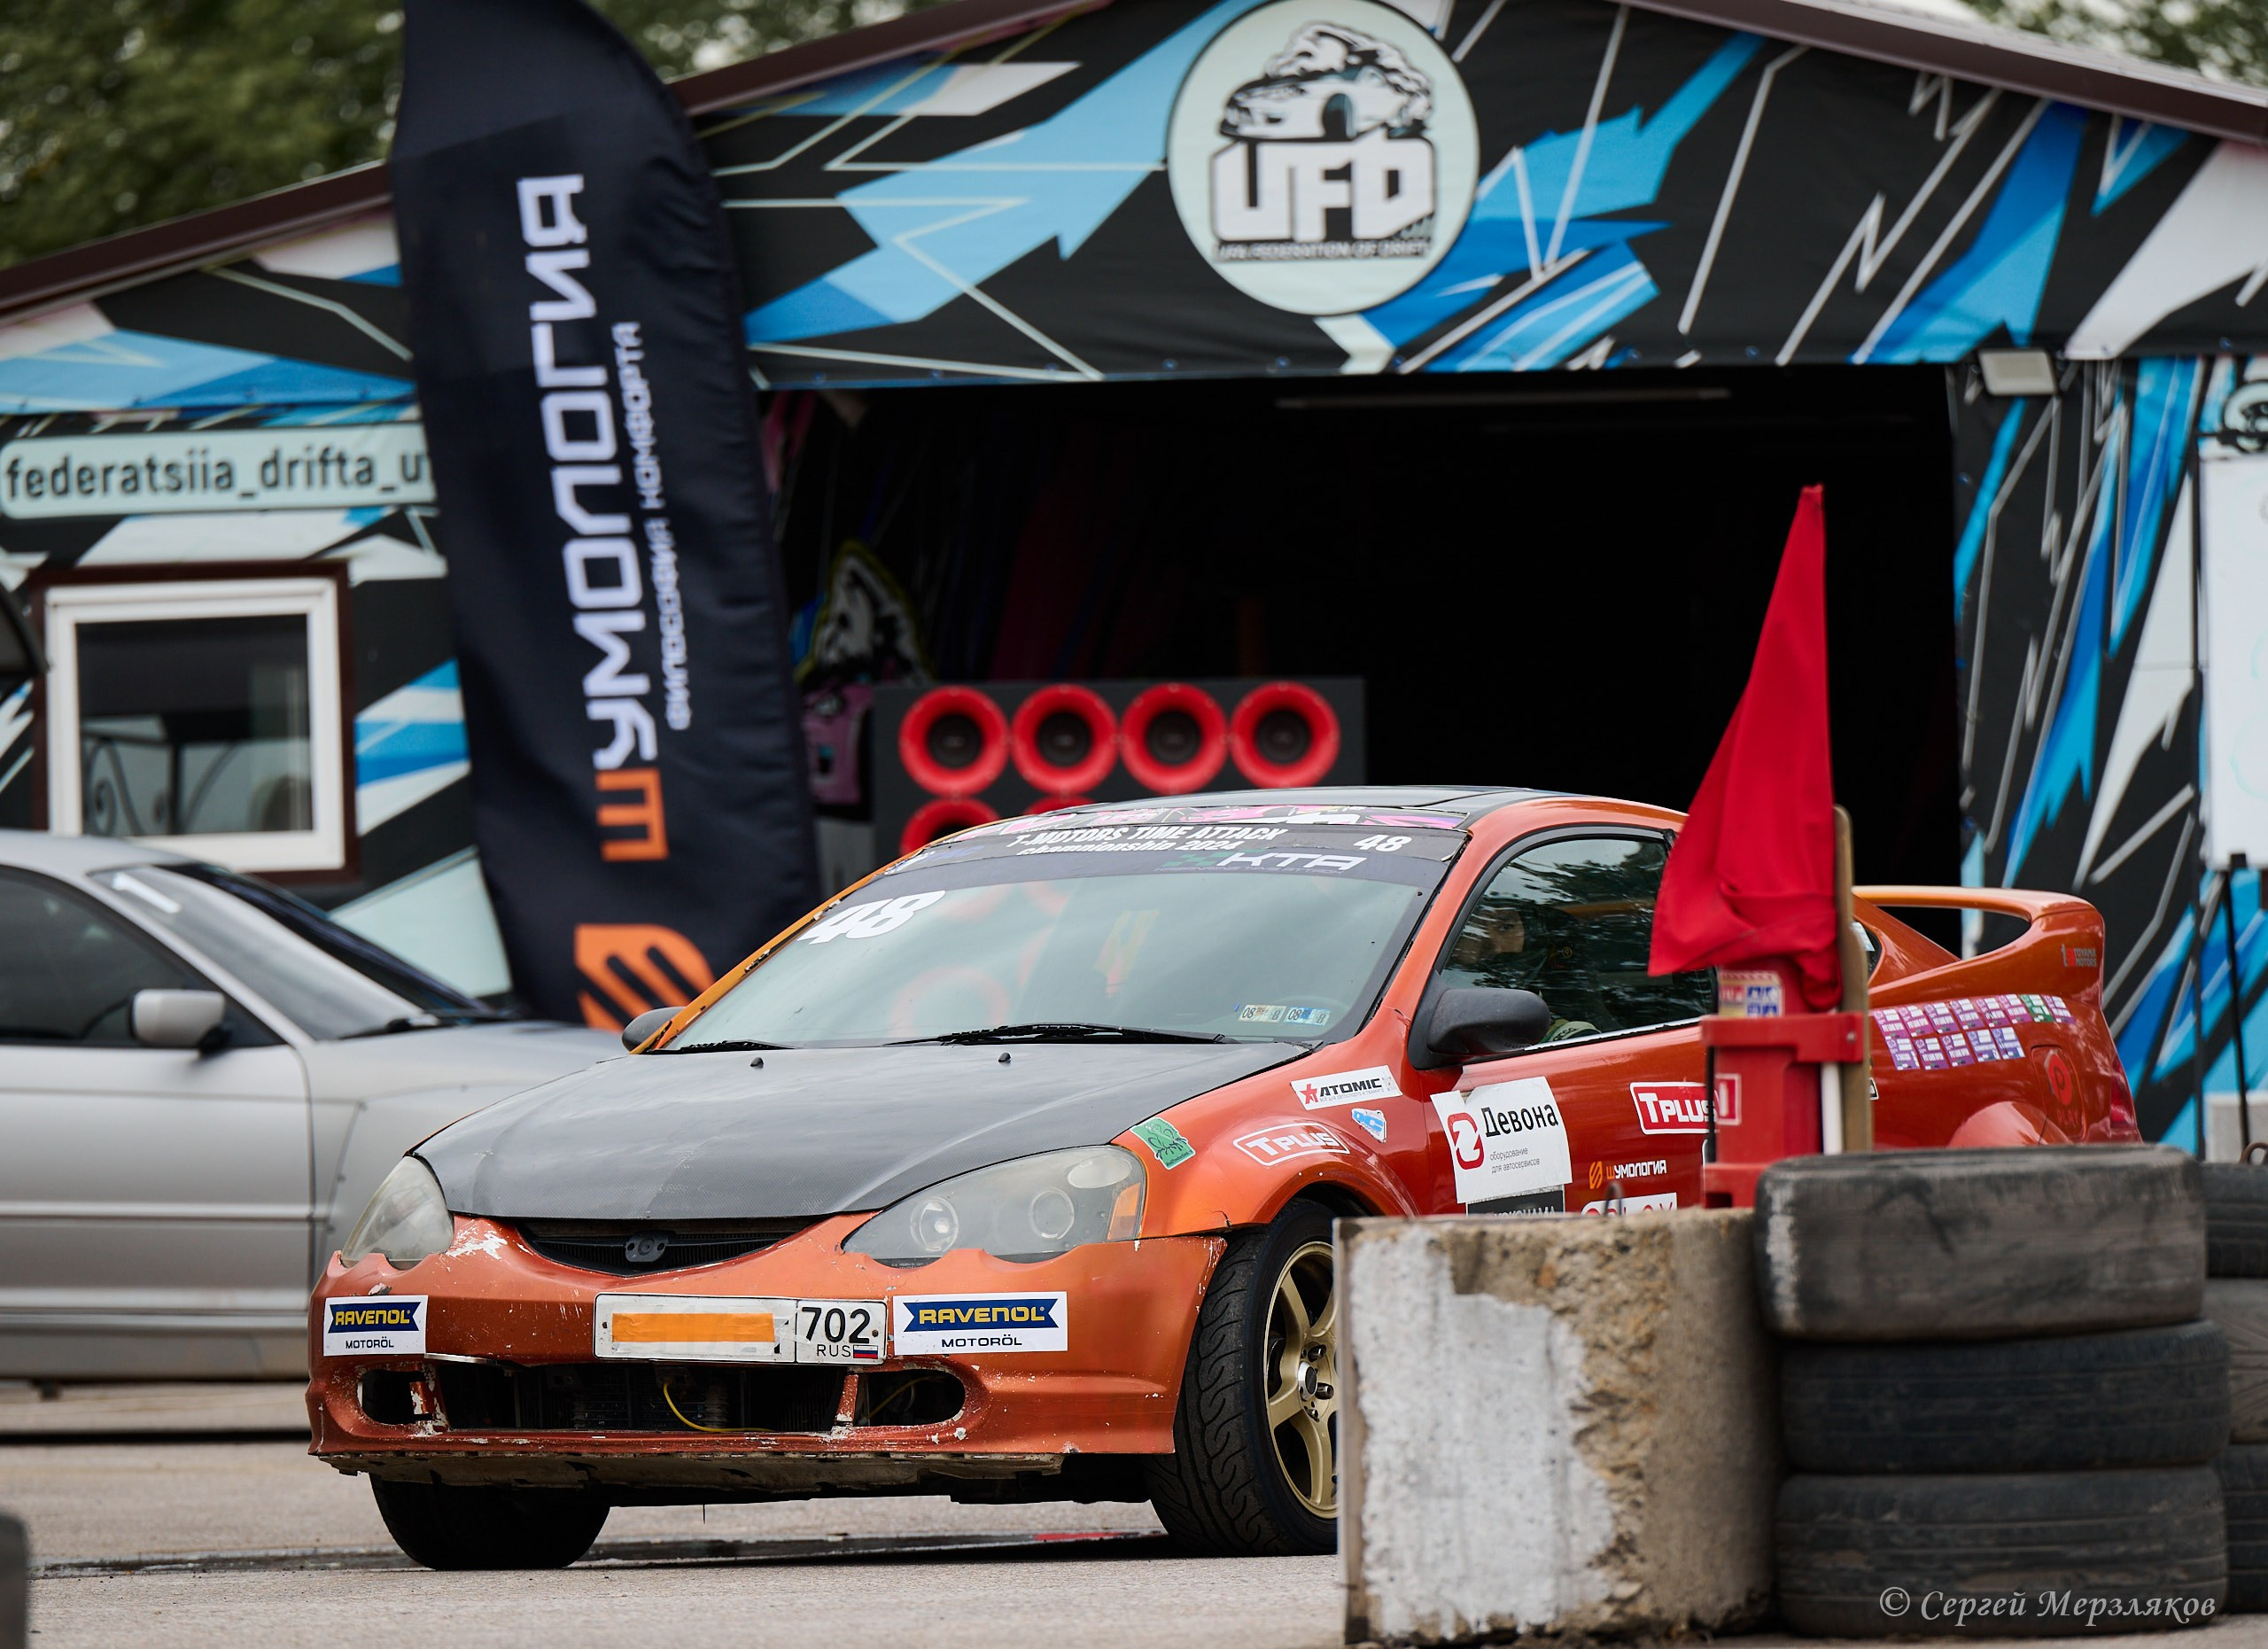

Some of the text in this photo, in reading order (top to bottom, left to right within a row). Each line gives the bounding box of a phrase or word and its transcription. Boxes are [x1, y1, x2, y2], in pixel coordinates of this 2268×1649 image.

[1212, 128, 1435, 243] UFD
[6, 447, 429, 502] federatsiia_drifta_u
[517, 175, 669, 861] ШУМОЛОГИЯ
[611, 322, 691, 730] ФИЛОСОФИЯ КОМФОРТА
[1127, 827, 1194, 840] TIME
[1185, 827, 1288, 840] ATTACK
[1353, 833, 1412, 852] 48
[1016, 840, 1244, 856] championship 2024
[1216, 852, 1367, 871] KTA
[797, 890, 946, 945] 48
[1320, 1077, 1382, 1098] ATOMIC
[1481, 1104, 1559, 1138] Девона
[1489, 1147, 1529, 1162] оборудование
[1491, 1156, 1541, 1174] для автосервисов
[1606, 1159, 1667, 1180] ШУМОЛОГИЯ
[335, 1309, 410, 1326] RAVENOL
[801, 1306, 870, 1344] 702
[919, 1307, 1045, 1325] RAVENOL
[346, 1336, 394, 1350] MOTORÖL
[941, 1334, 1022, 1348] MOTORÖL
[816, 1345, 851, 1358] RUS
